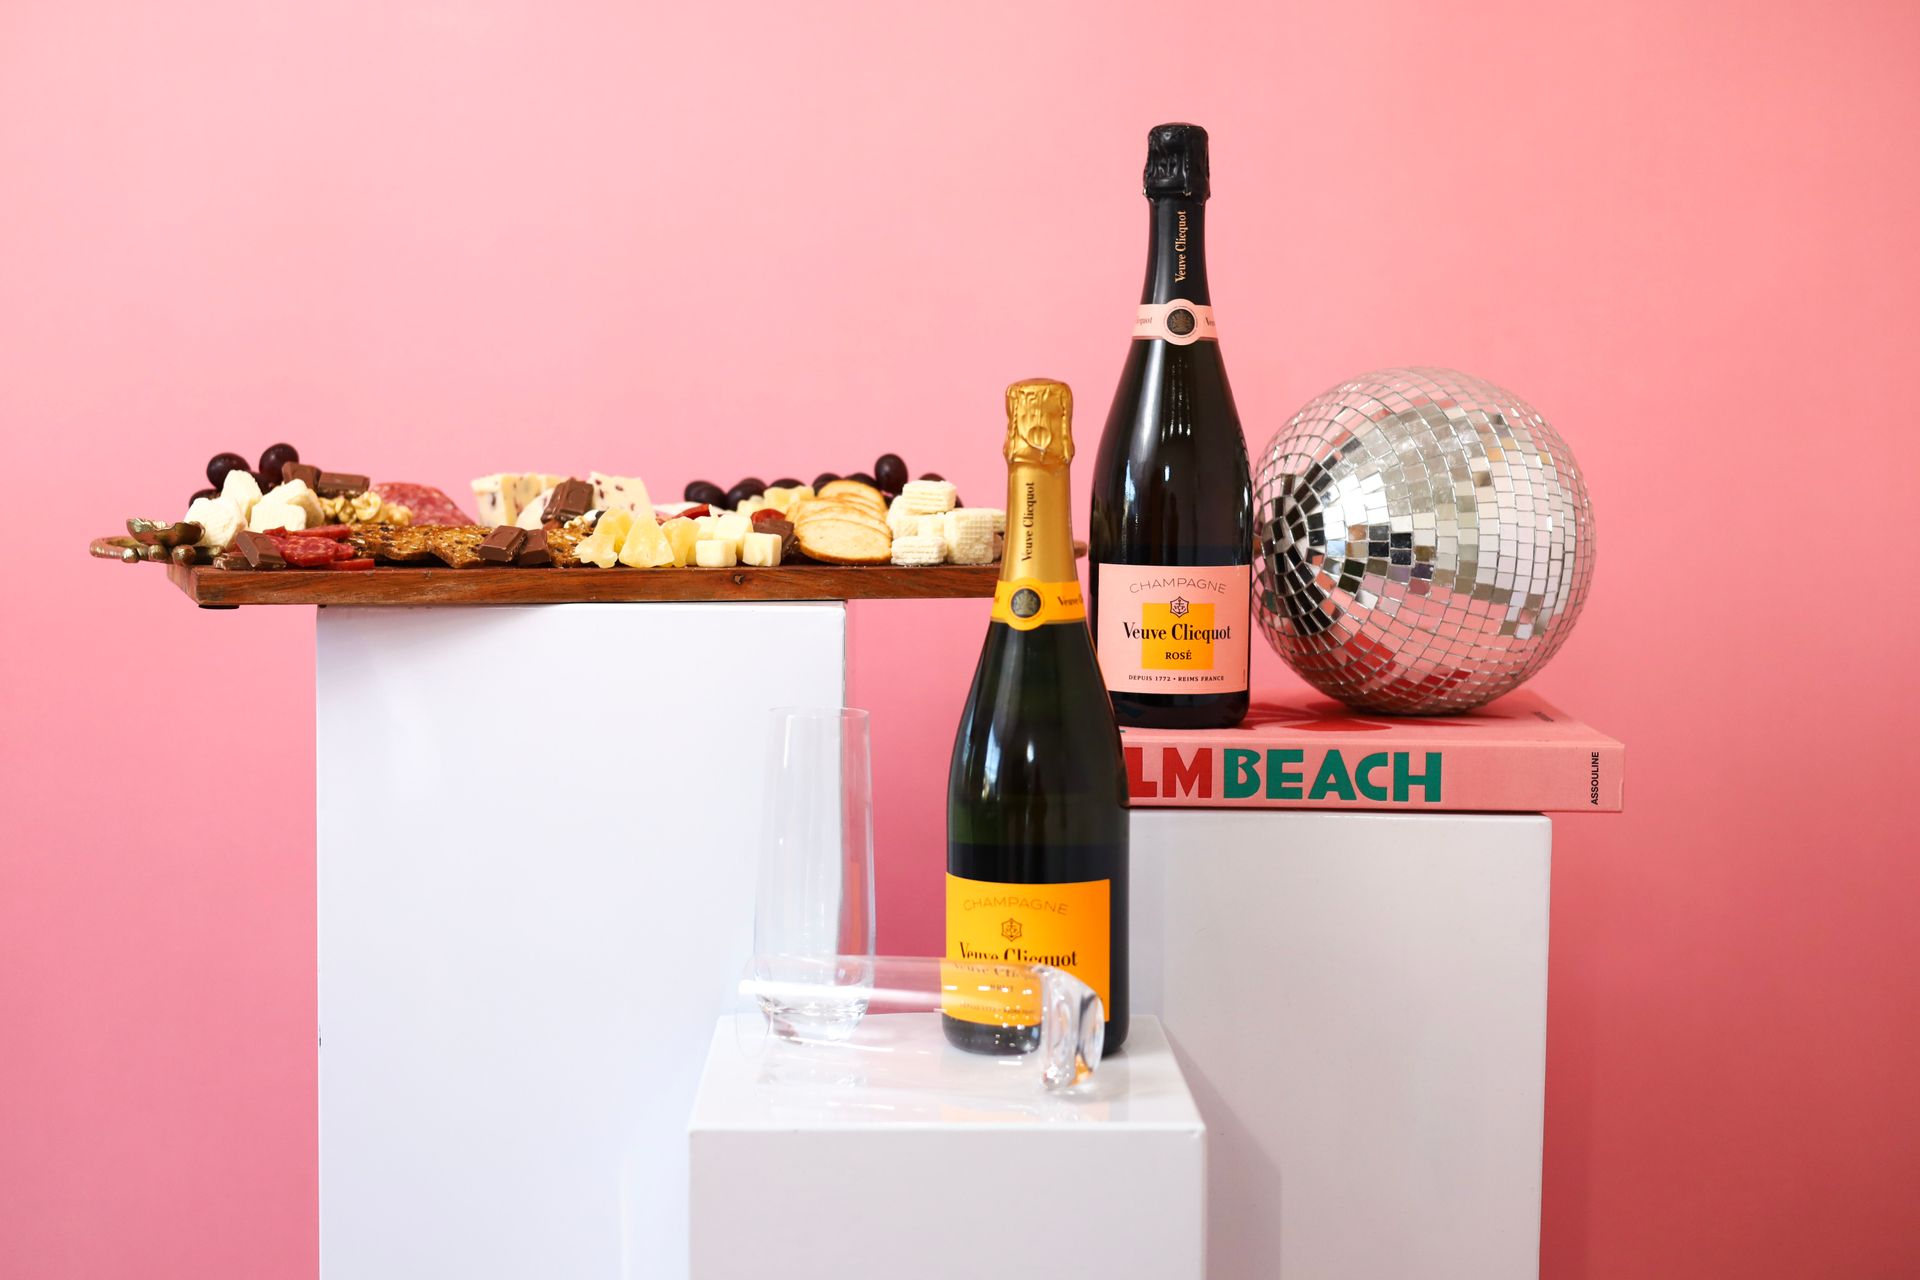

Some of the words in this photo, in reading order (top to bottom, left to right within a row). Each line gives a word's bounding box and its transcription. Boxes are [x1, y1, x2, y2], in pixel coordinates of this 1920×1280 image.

[1175, 210, 1188, 252] Clicquot
[1175, 254, 1187, 283] Veuve
[1023, 482, 1037, 528] Clicquot
[1021, 530, 1034, 562] Veuve
[1129, 577, 1227, 594] CHAMPAGNE
[1123, 621, 1167, 640] Veuve
[1171, 623, 1231, 644] Clicquot
[1165, 649, 1192, 660] ROSÉ
[1124, 747, 1213, 798] LM
[1223, 748, 1442, 802] BEACH
[1590, 751, 1600, 806] ASSOULINE
[963, 896, 1069, 916] CHAMPAGNE
